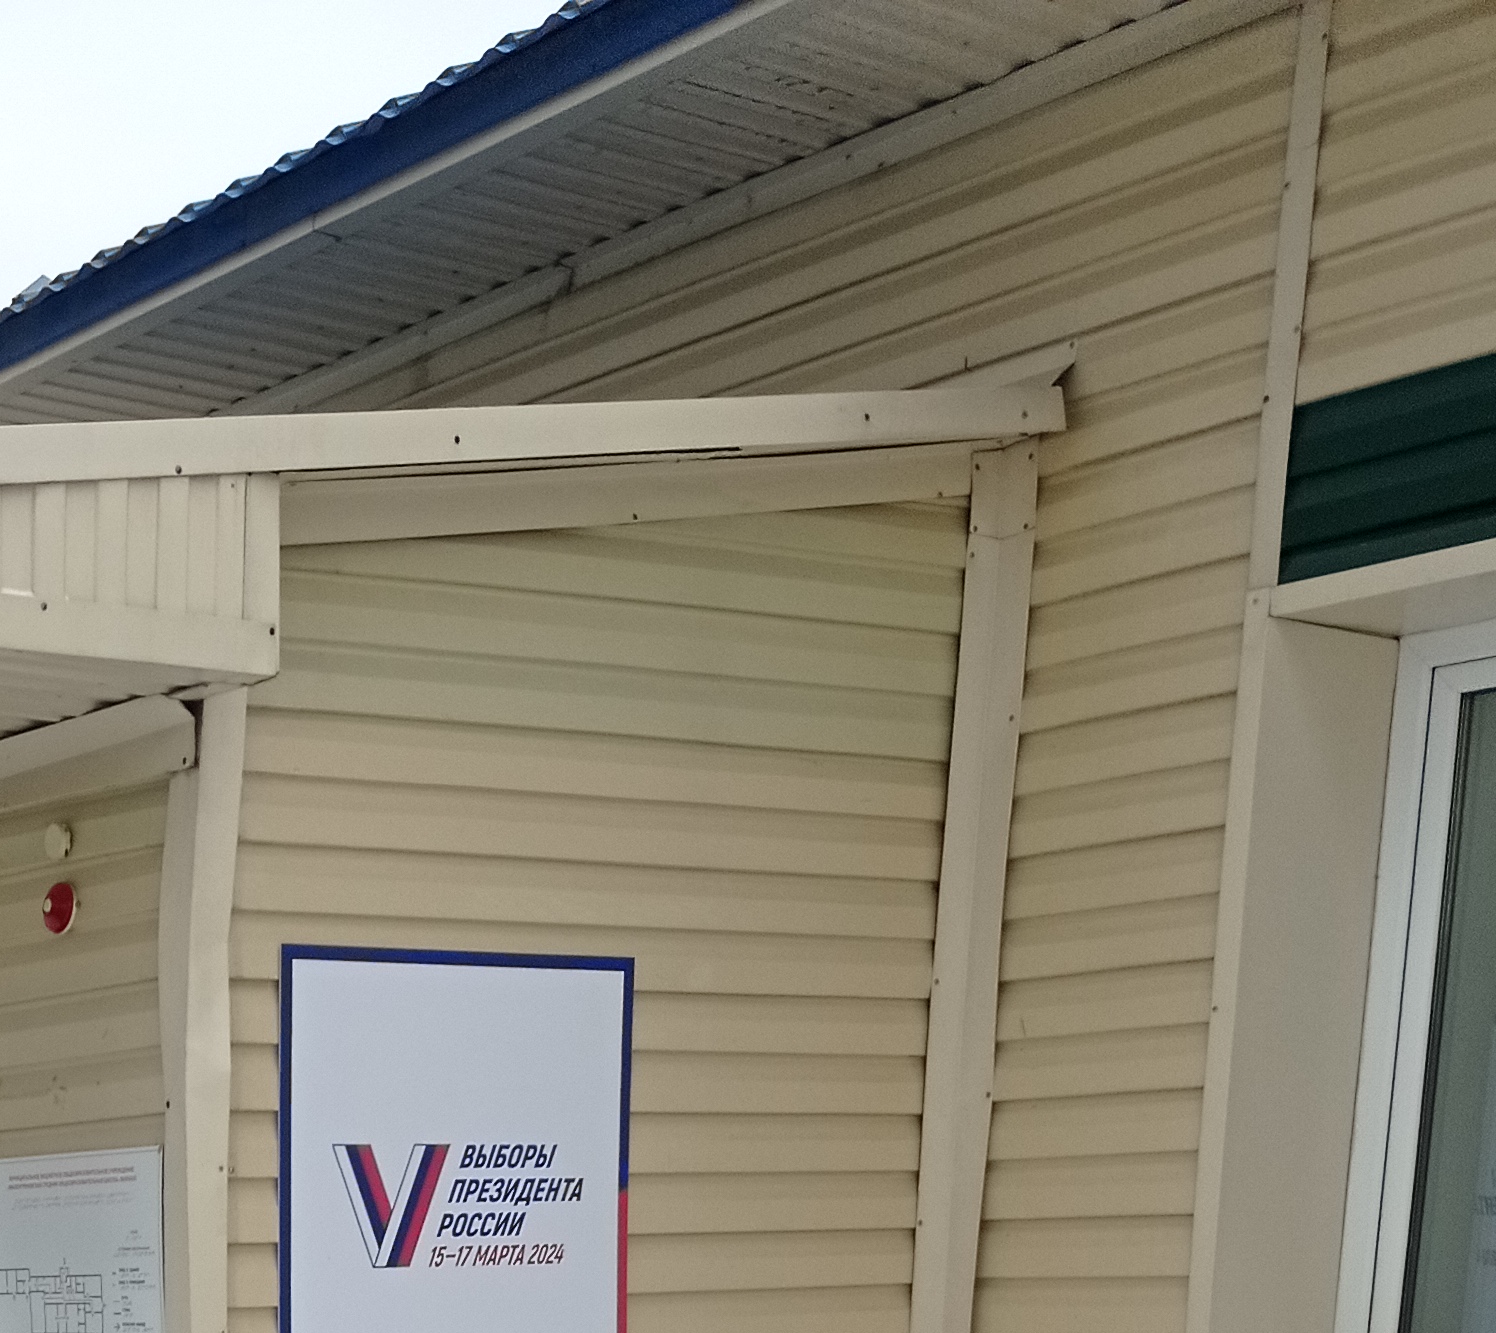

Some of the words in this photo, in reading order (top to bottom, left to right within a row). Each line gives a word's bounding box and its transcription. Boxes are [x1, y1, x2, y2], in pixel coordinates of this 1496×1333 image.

[459, 1144, 558, 1169] ВЫБОРЫ
[448, 1177, 584, 1206] ПРЕЗИДЕНТА
[436, 1211, 527, 1237] РОССИИ
[472, 1243, 525, 1267] МАРТА
[527, 1243, 565, 1266] 2024
